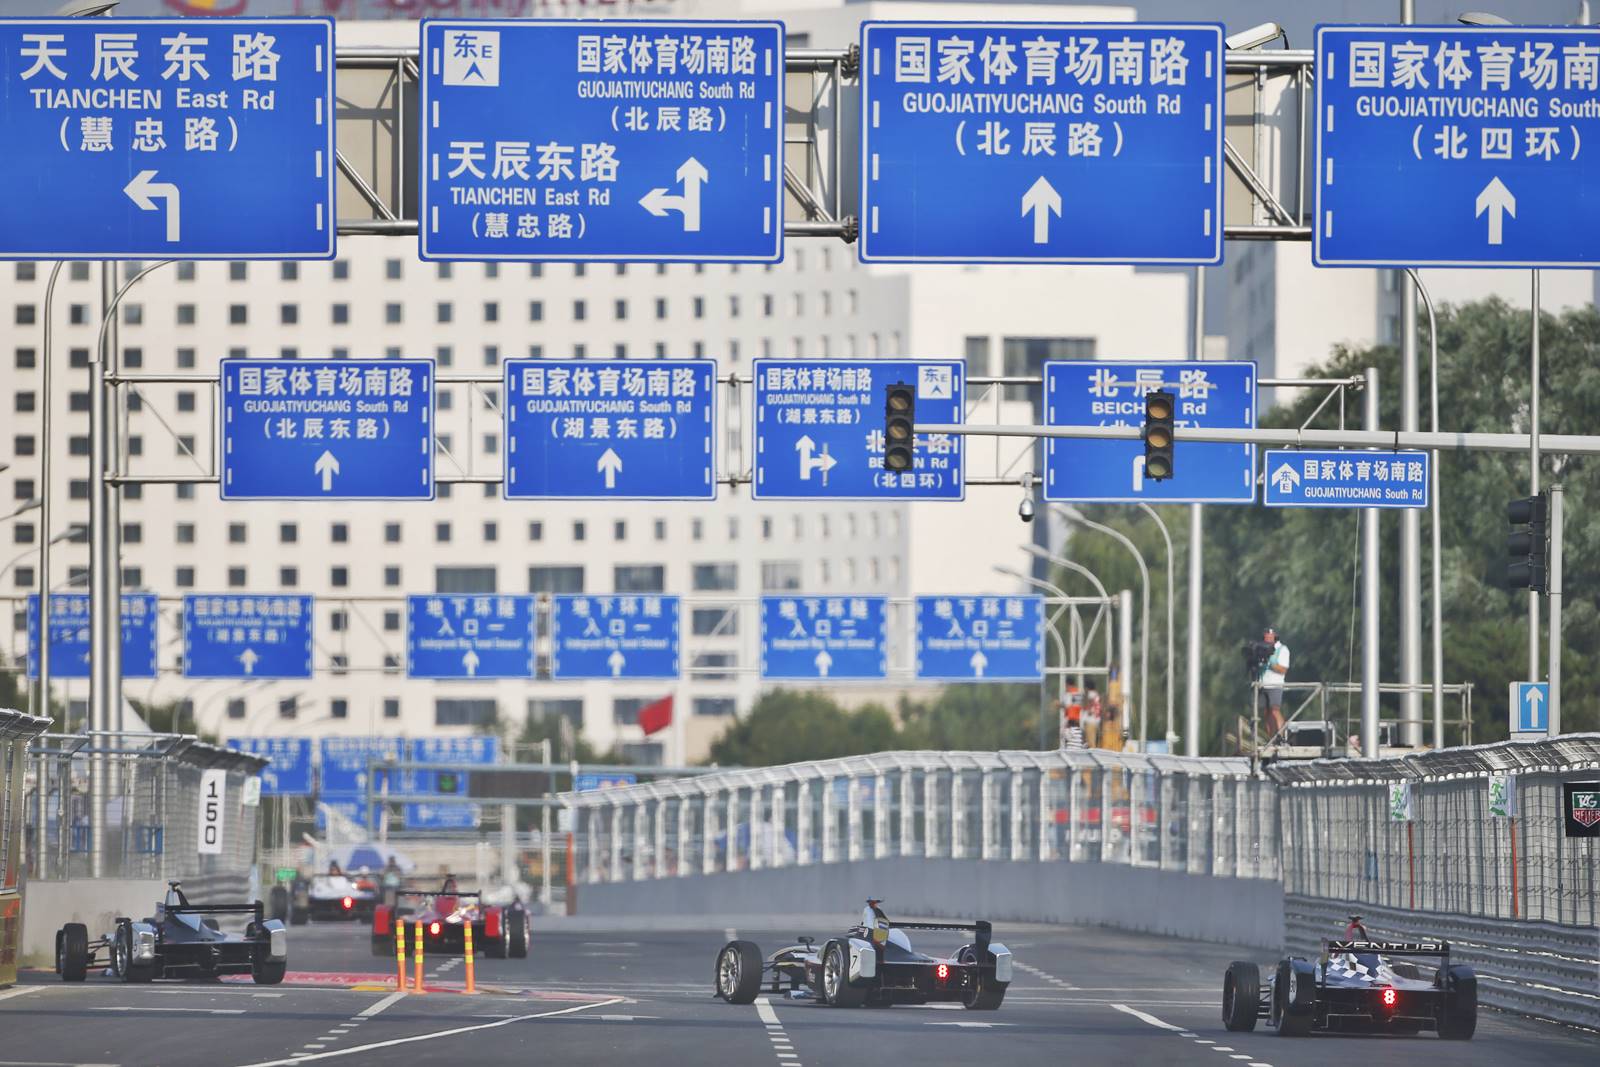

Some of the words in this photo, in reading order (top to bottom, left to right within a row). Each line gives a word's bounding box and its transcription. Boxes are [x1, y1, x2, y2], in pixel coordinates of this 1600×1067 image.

[20, 32, 280, 81] 天辰东路
[453, 33, 478, 59] 东
[481, 45, 493, 59] E
[578, 35, 756, 74] 国家体育场南路
[895, 36, 1189, 86] 国家体育场南路
[1349, 40, 1600, 91] 国家体育场南
[30, 89, 161, 109] TIANCHEN
[177, 88, 228, 108] East
[243, 90, 274, 110] Rd
[578, 81, 693, 98] GUOJIATIYUCHANG
[700, 81, 733, 98] South
[740, 81, 754, 98] Rd
[903, 92, 1083, 113] GUOJIATIYUCHANG
[1094, 94, 1146, 114] South
[1158, 94, 1180, 114] Rd
[1357, 96, 1538, 117] GUOJIATIYUCHANG
[1549, 98, 1600, 117] South
[448, 141, 620, 181] 天辰东路
[450, 187, 536, 205] TIANCHEN
[545, 188, 579, 205] East
[589, 188, 609, 205] Rd
[240, 367, 413, 396] 国家体育场南路
[523, 367, 696, 397] 国家体育场南路
[767, 368, 872, 391] 国家体育场南路
[1088, 369, 1210, 399] 北辰路
[244, 400, 351, 412] GUOJIATIYUCHANG
[356, 400, 388, 412] South
[393, 400, 408, 412] Rd
[527, 400, 634, 413] GUOJIATIYUCHANG
[640, 400, 671, 413] South
[676, 401, 691, 414] Rd
[861, 394, 870, 404] Rd
[1092, 402, 1147, 415] BEICH
[1183, 403, 1206, 414] Rd
[866, 430, 951, 454] 北路
[931, 457, 949, 469] Rd
[1304, 459, 1423, 482] 国家体育场南路
[1305, 486, 1381, 498] GUOJIATIYUCHANG
[1385, 488, 1408, 500] South
[1412, 489, 1423, 500] Rd
[437, 617, 505, 636] 入口一
[583, 617, 651, 636] 入口一
[789, 617, 858, 638] 入口二
[947, 617, 1015, 638] 入口二
[1577, 794, 1598, 808] TAG
[204, 781, 219, 845] 150
[1335, 941, 1443, 951] VENTURI
[851, 955, 858, 969] 7
